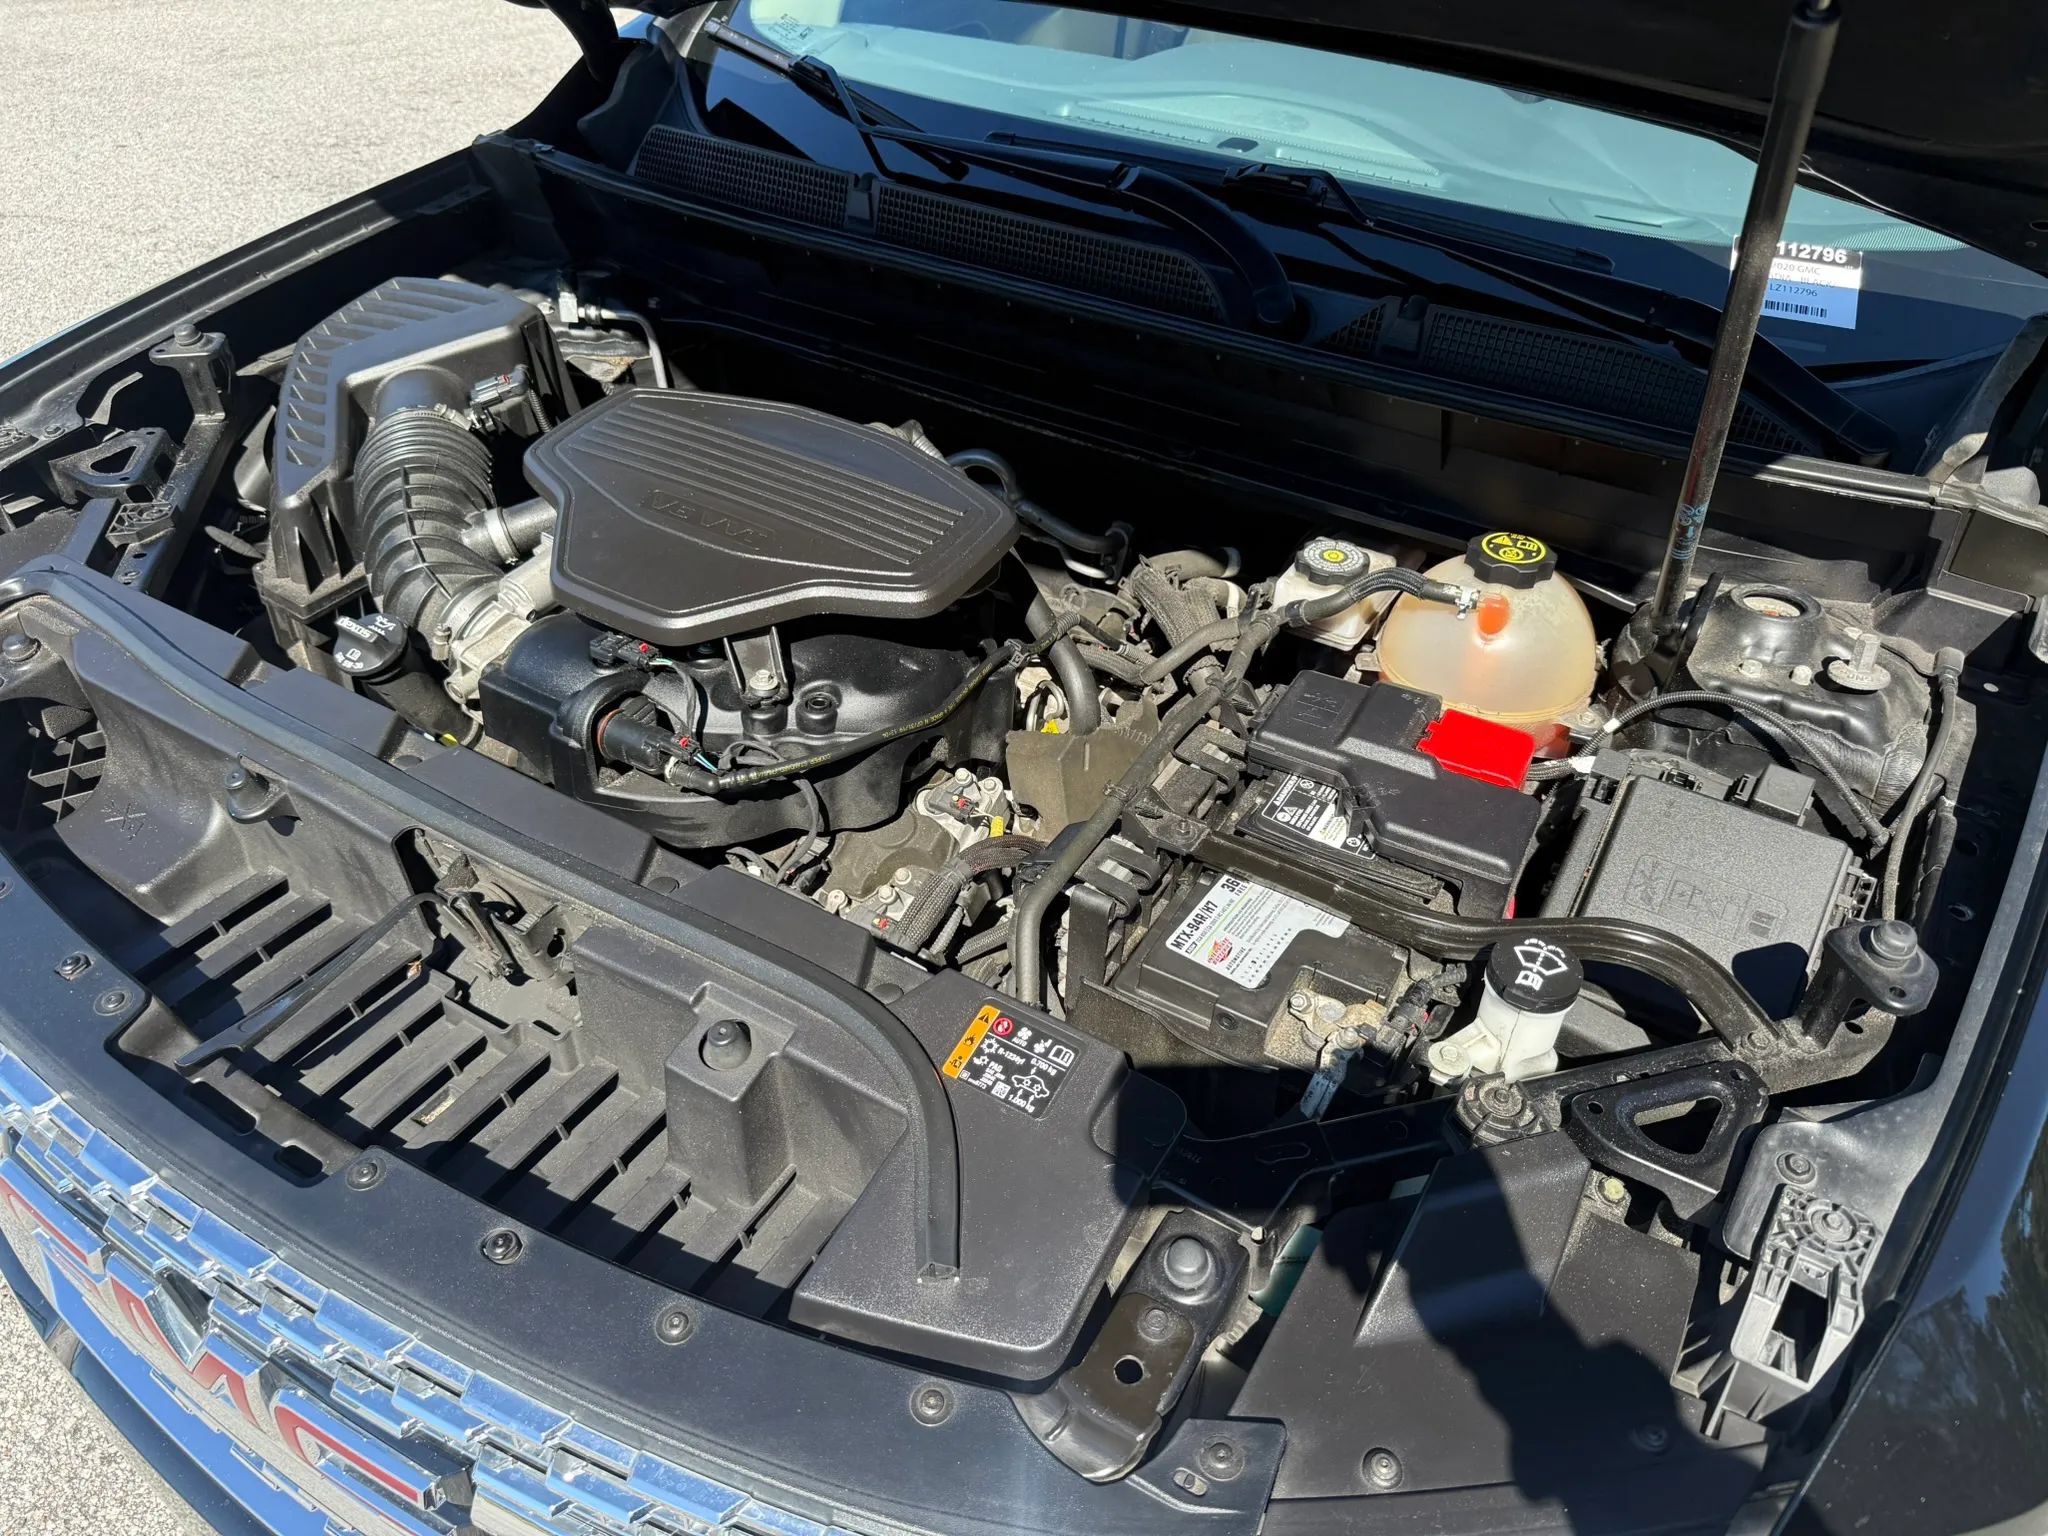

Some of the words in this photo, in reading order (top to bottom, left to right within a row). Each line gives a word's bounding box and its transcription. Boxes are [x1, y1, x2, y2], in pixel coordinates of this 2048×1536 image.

[1771, 262, 1795, 272] 020
[1797, 265, 1821, 276] GMC
[1171, 900, 1218, 950] MTX-94R/H7
[1221, 877, 1240, 893] 36
[1011, 1037, 1028, 1047] AUTO
[1046, 1066, 1058, 1076] kg
